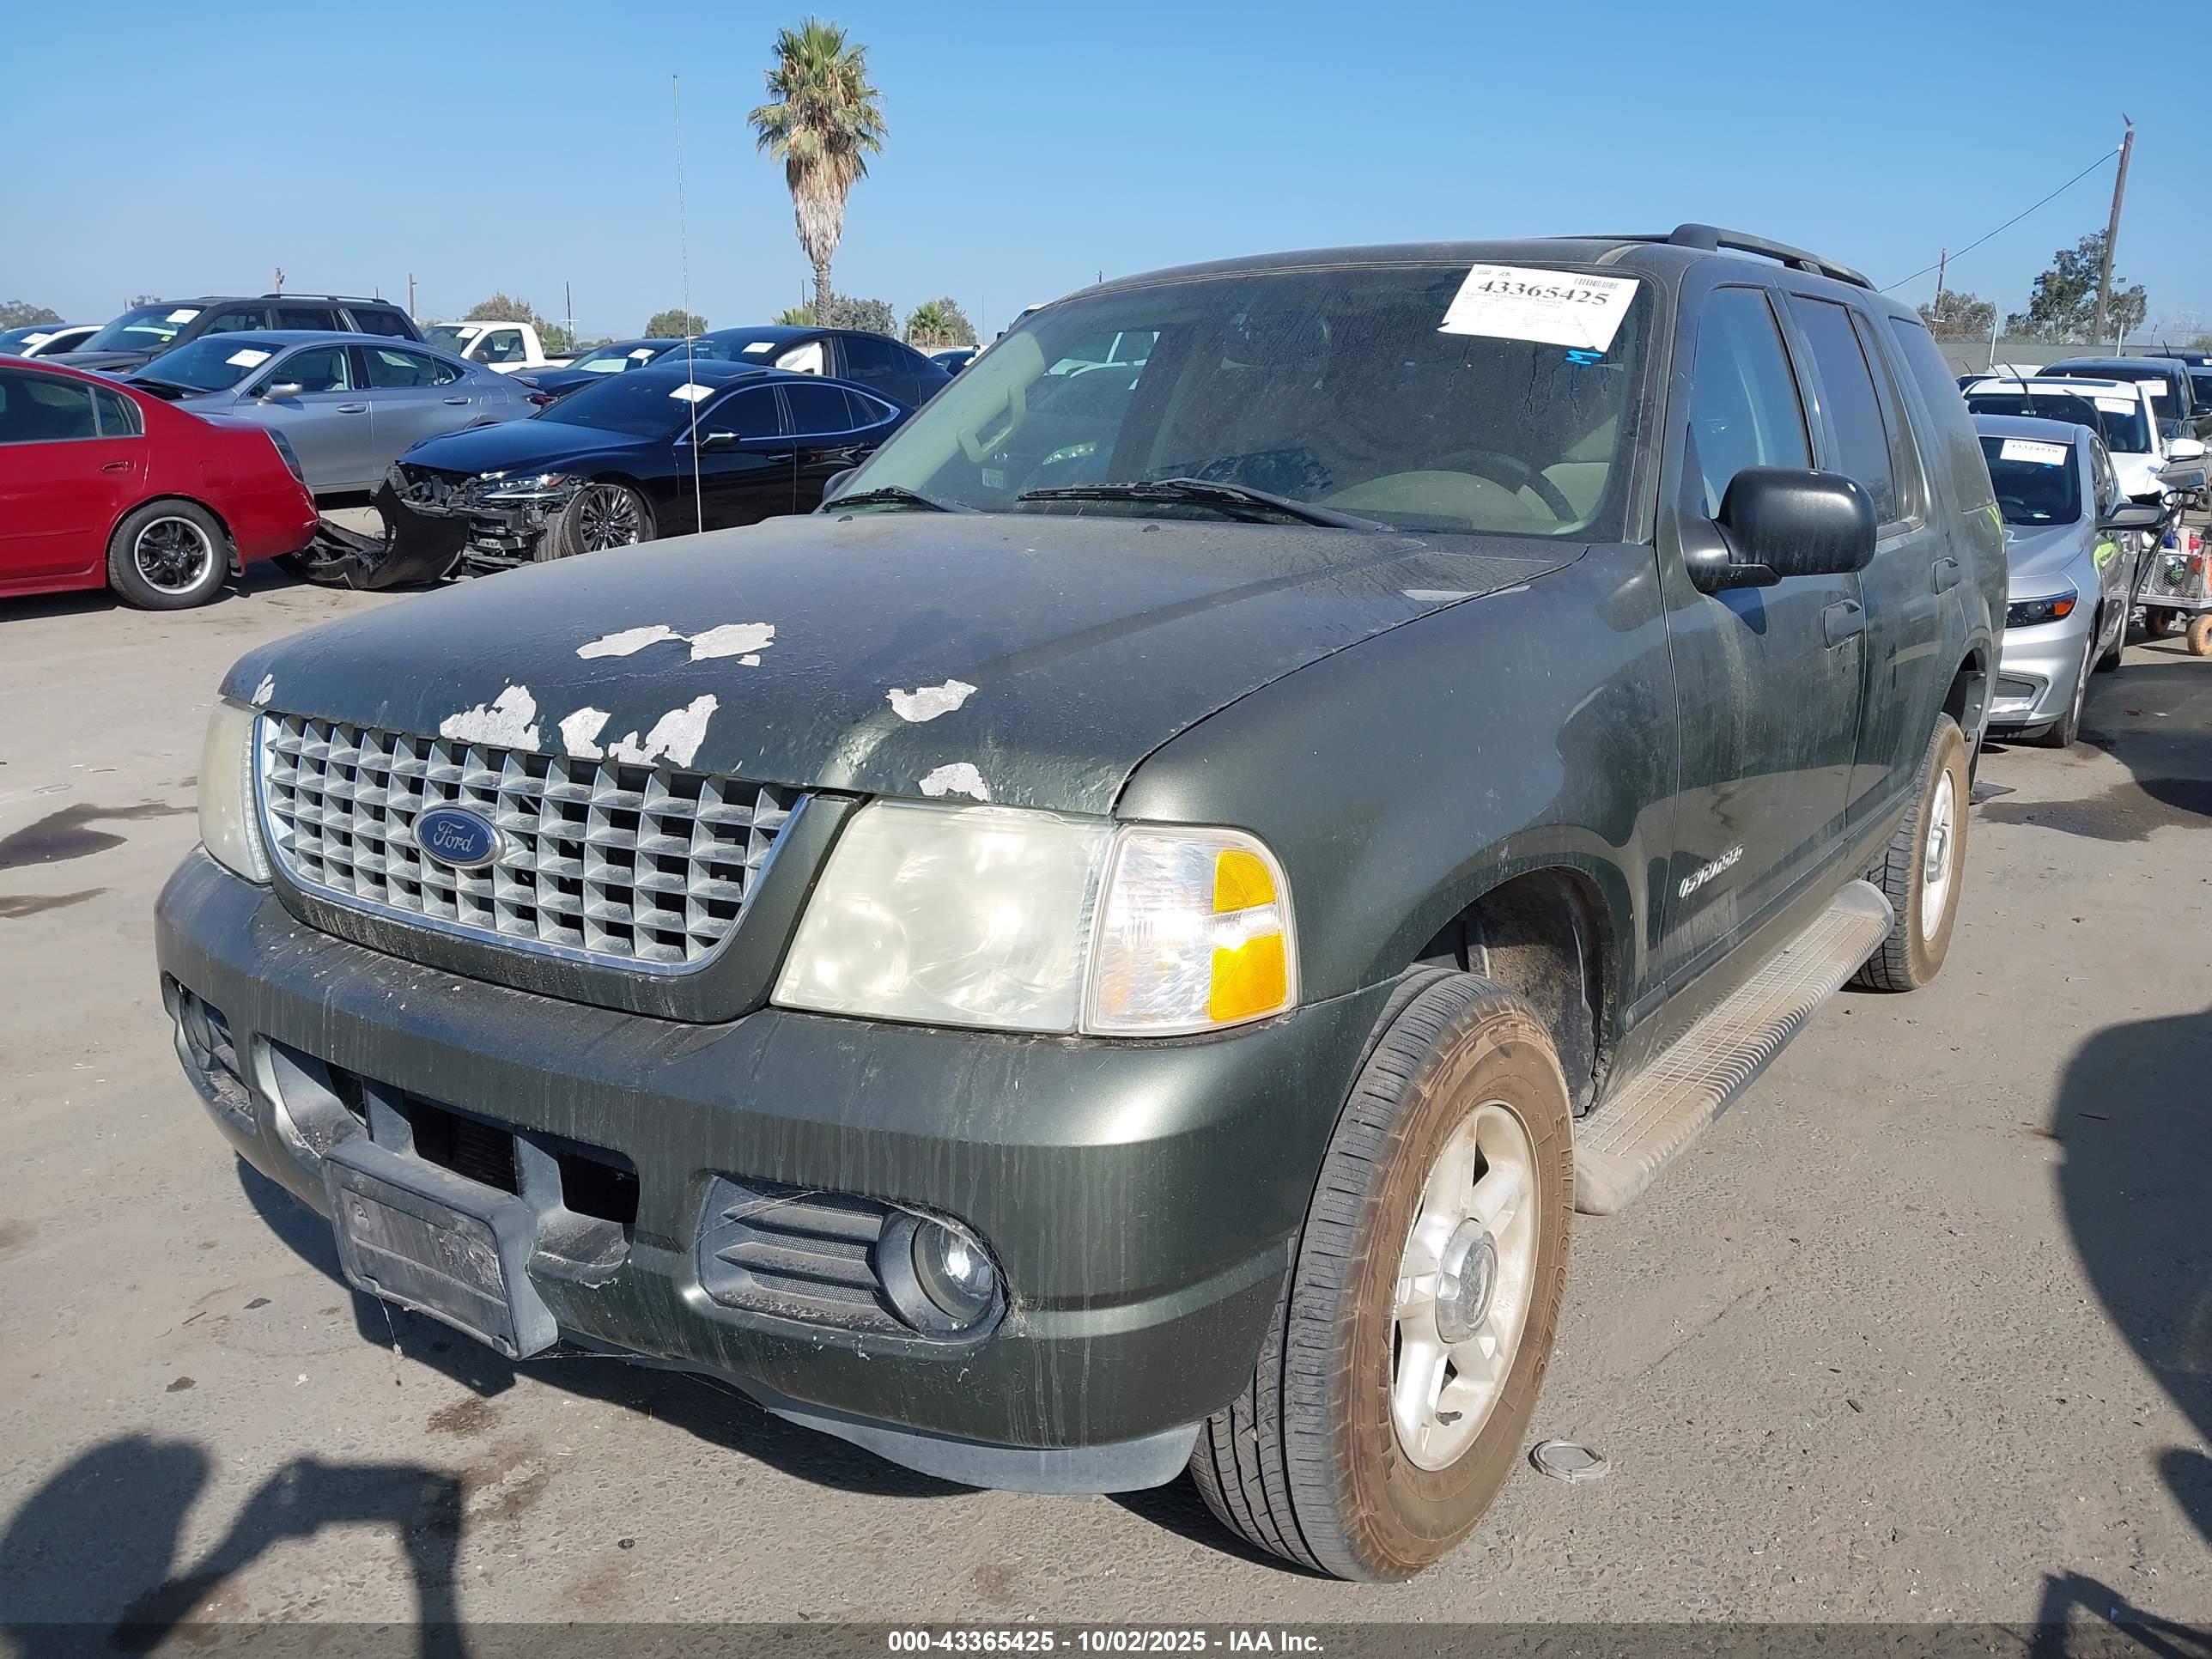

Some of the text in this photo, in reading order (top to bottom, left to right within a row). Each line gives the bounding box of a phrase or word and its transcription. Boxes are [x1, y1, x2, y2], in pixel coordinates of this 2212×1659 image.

[1478, 280, 1610, 306] 43365425
[433, 820, 476, 853] Ford
[1531, 1148, 1574, 1390] HERCULES
